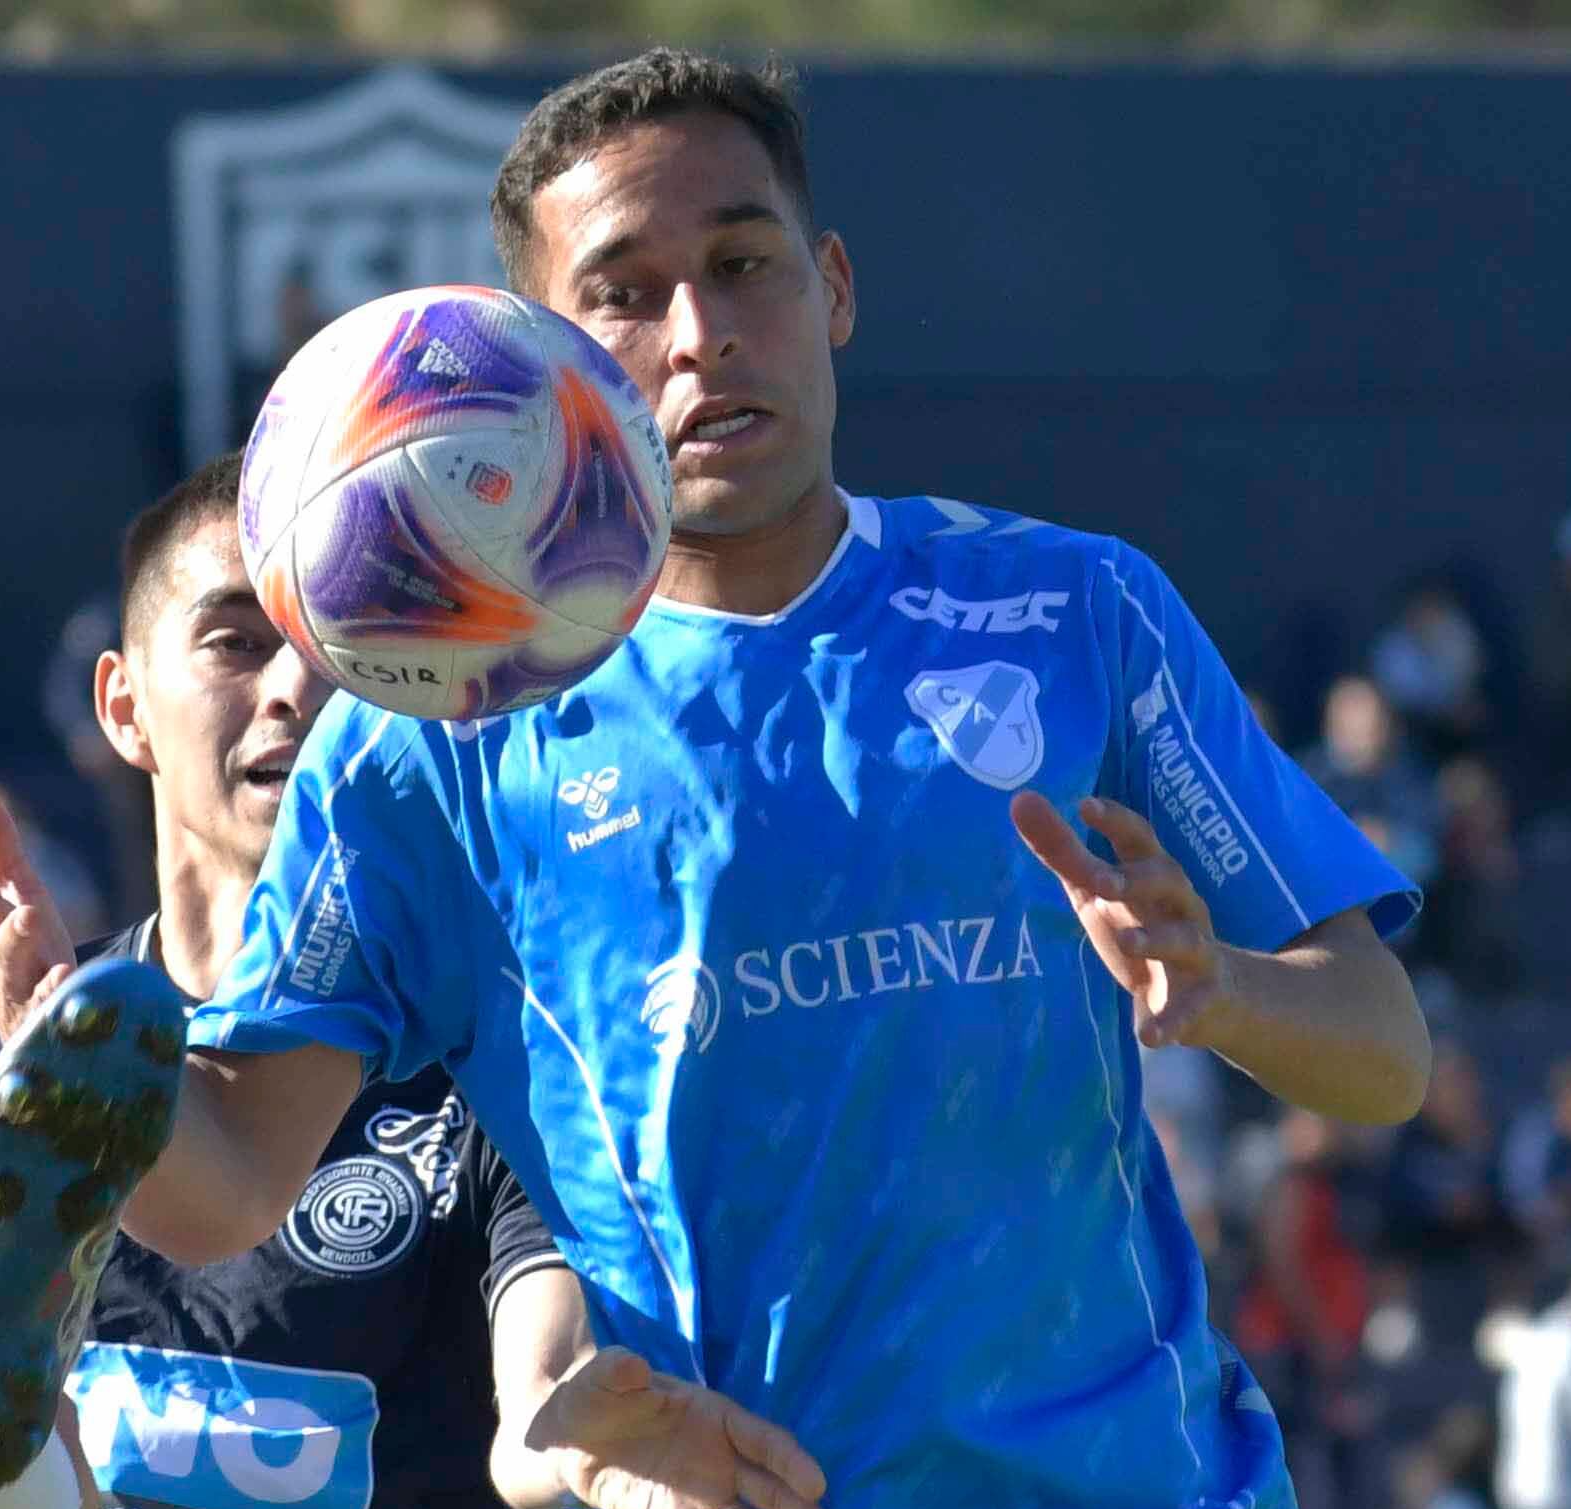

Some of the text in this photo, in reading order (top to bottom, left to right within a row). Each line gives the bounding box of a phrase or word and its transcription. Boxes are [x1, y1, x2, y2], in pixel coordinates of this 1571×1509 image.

[889, 586, 1070, 633] CETEC
[567, 805, 641, 853] hummel
[1154, 724, 1249, 875] MUNICIPIO
[318, 934, 353, 997] LOMAS
[735, 911, 1043, 1022] SCIENZA
